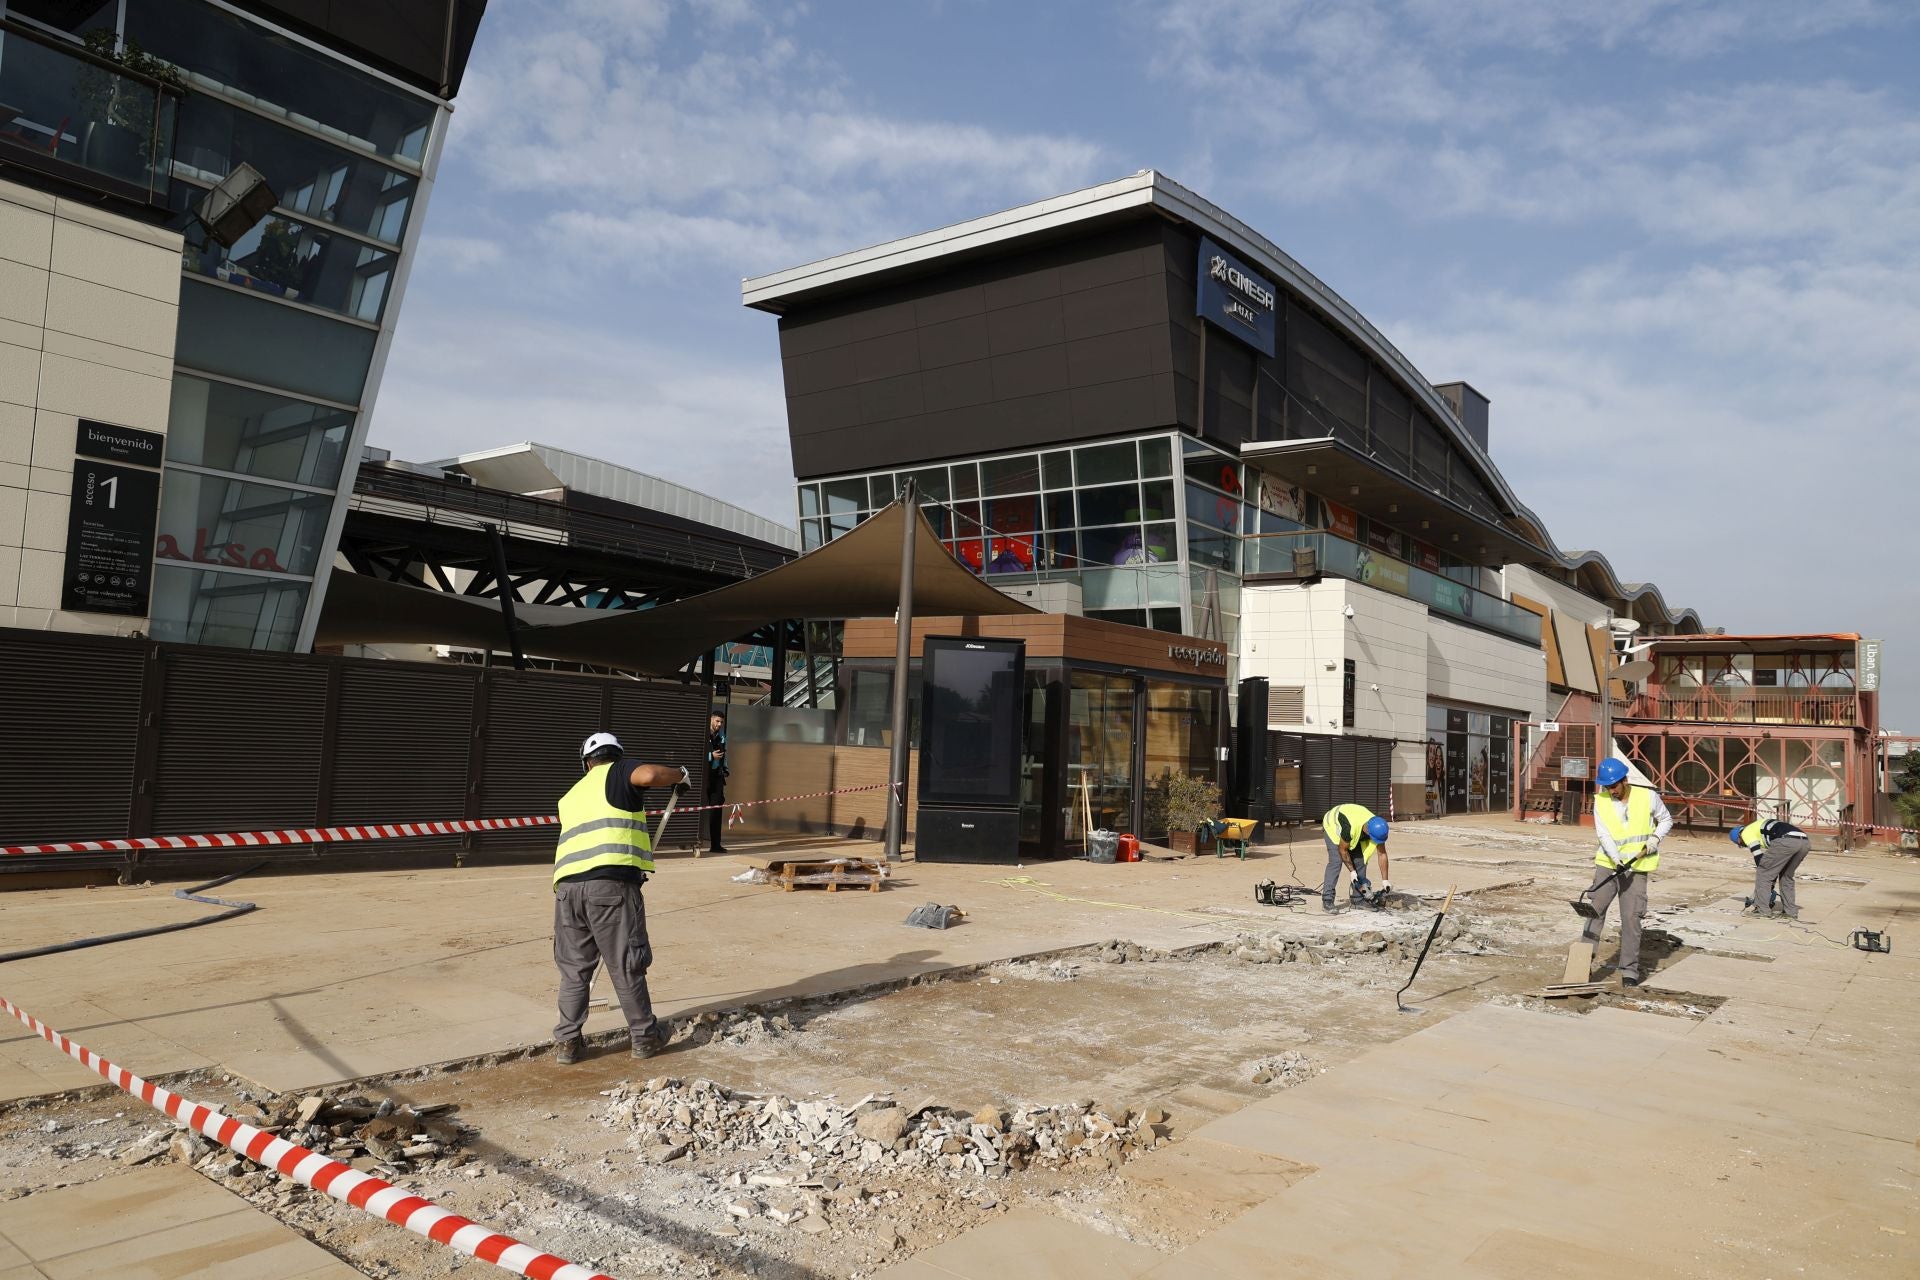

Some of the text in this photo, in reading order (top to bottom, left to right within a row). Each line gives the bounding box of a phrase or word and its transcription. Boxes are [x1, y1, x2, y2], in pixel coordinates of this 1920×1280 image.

[1228, 267, 1274, 311] CINESA
[1232, 302, 1254, 322] LUXE
[88, 428, 153, 451] bienvenido
[85, 472, 96, 506] acceso
[100, 476, 118, 509] 1
[1168, 645, 1225, 667] recepción
[1866, 644, 1878, 671] Liban,
